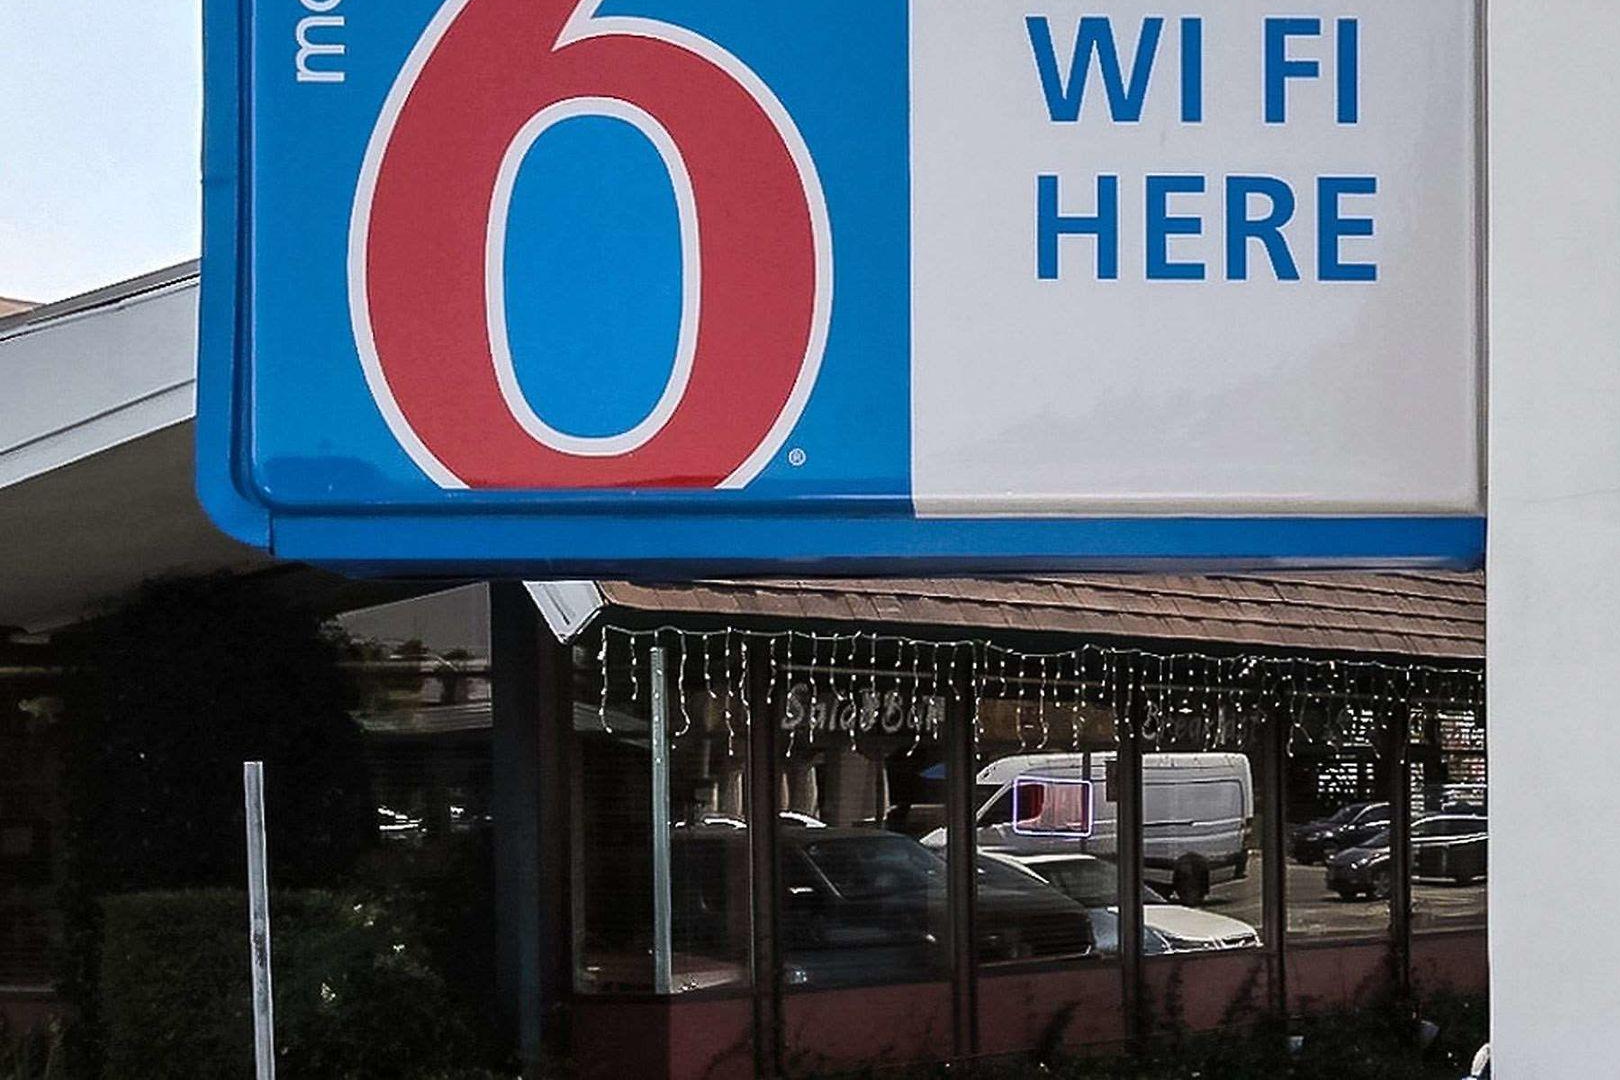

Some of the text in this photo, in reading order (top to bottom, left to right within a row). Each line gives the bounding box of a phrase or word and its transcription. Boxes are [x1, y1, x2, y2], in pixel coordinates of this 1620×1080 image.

[1024, 15, 1359, 125] WI FI
[1035, 173, 1379, 283] HERE
